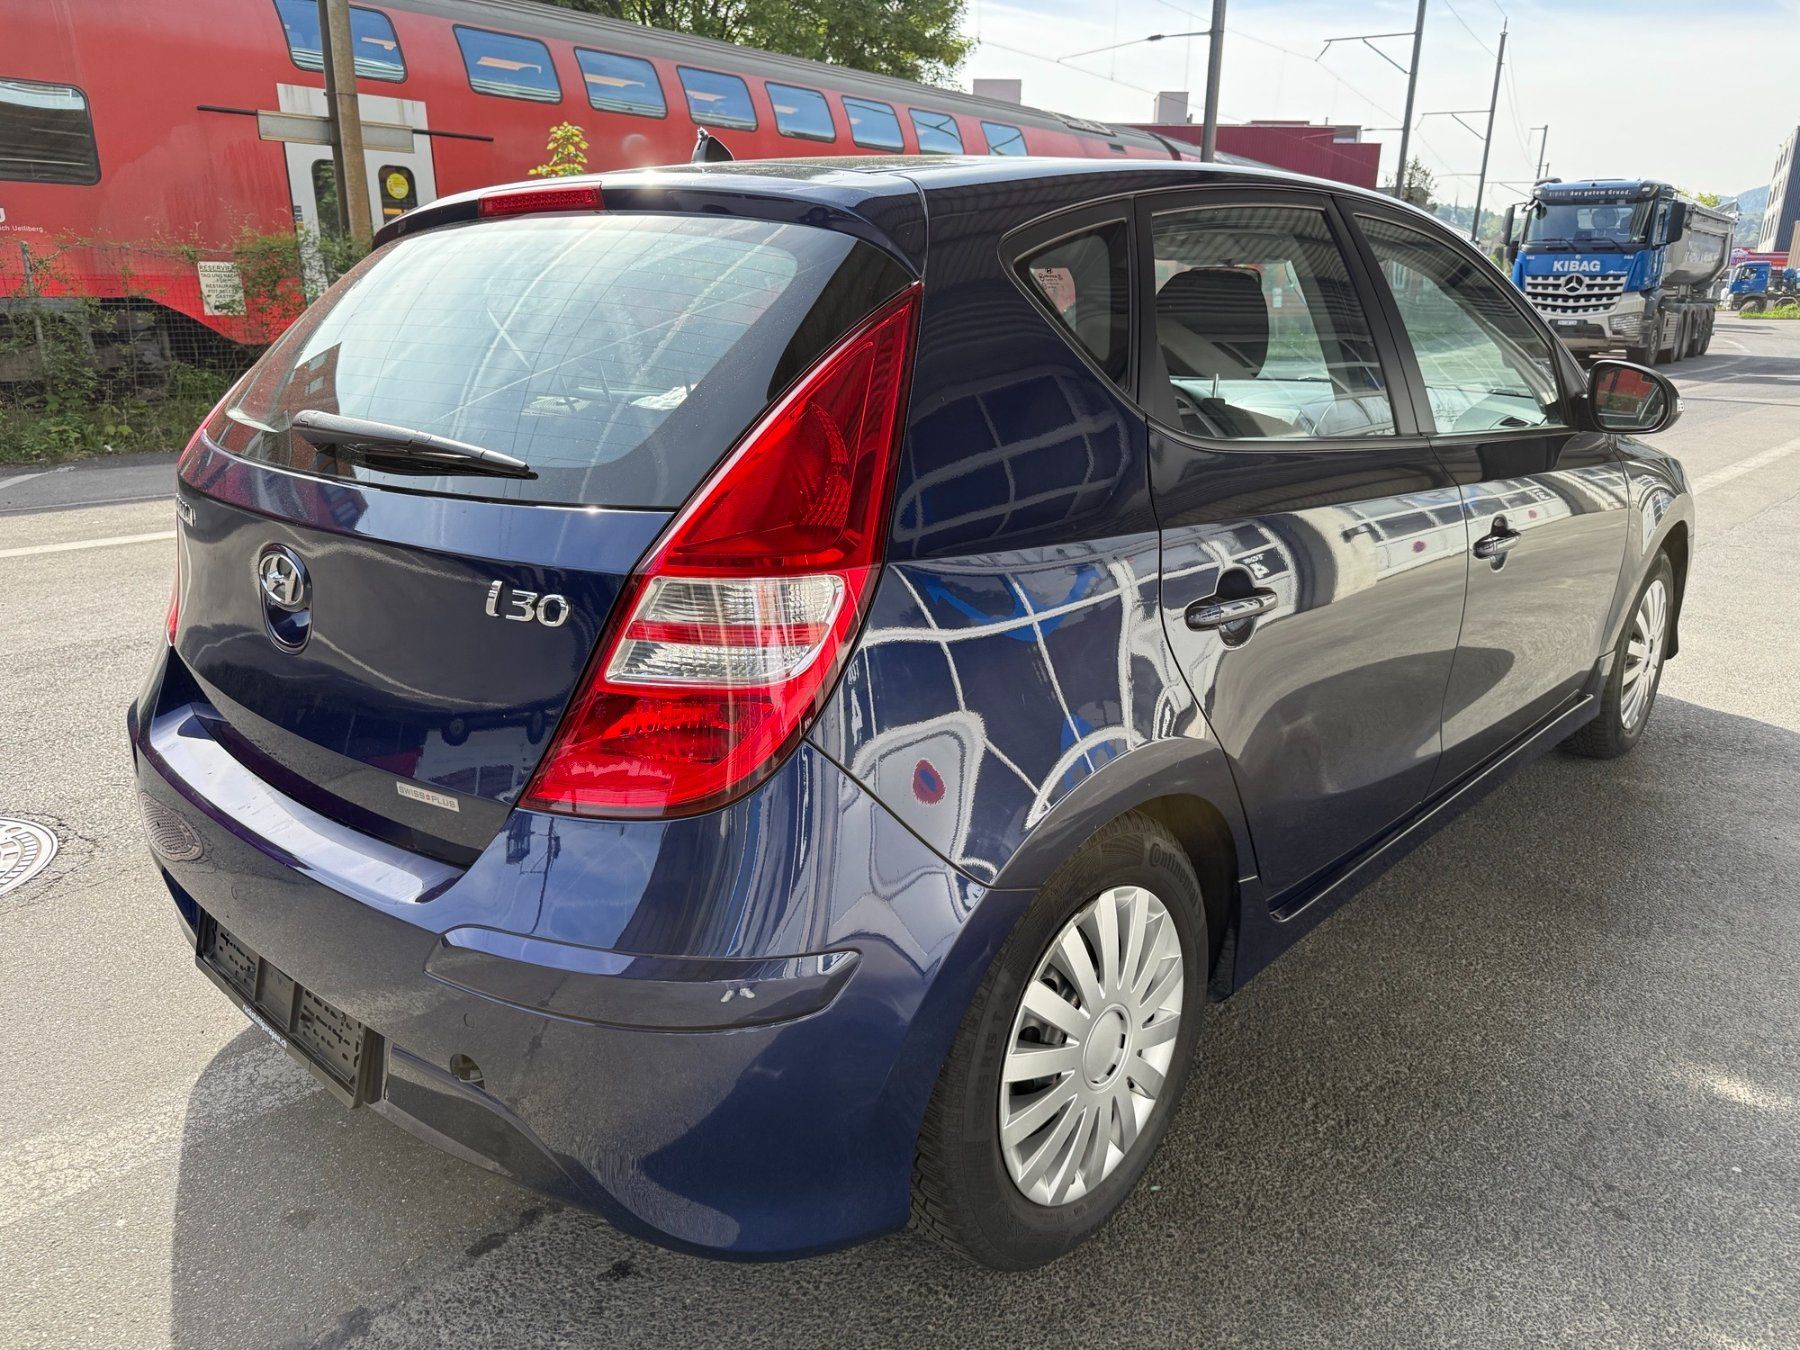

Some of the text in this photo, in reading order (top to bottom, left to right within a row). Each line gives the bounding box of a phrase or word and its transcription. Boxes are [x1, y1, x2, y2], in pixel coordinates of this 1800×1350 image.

[1584, 189, 1606, 197] gutem
[1552, 260, 1601, 272] KIBAG
[398, 785, 457, 808] SWISS PLUS
